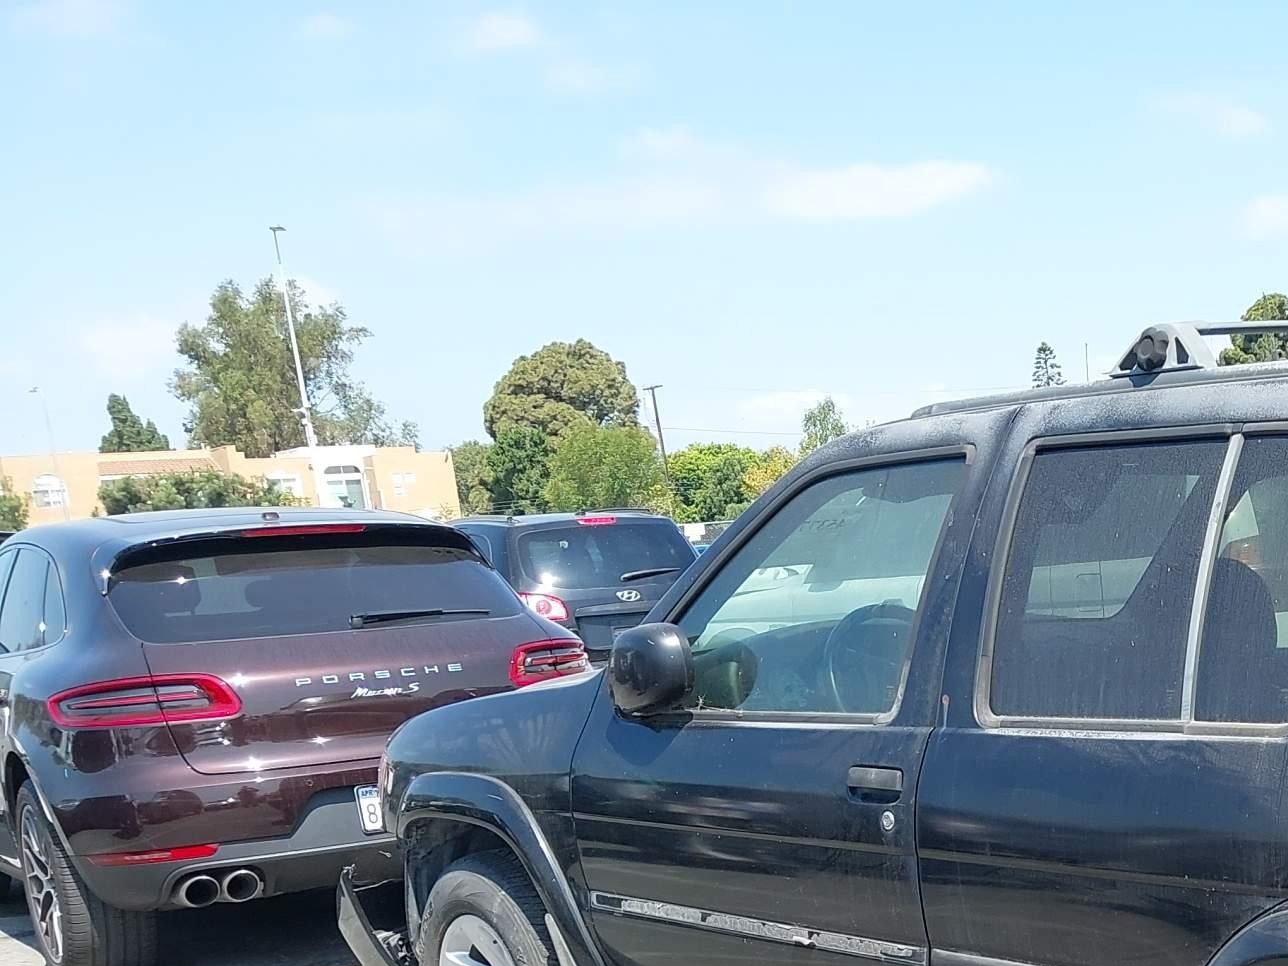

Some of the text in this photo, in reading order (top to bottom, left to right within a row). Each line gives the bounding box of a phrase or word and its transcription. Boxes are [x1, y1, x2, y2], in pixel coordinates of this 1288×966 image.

[295, 662, 464, 687] PORSCHE
[350, 682, 421, 699] Macan S
